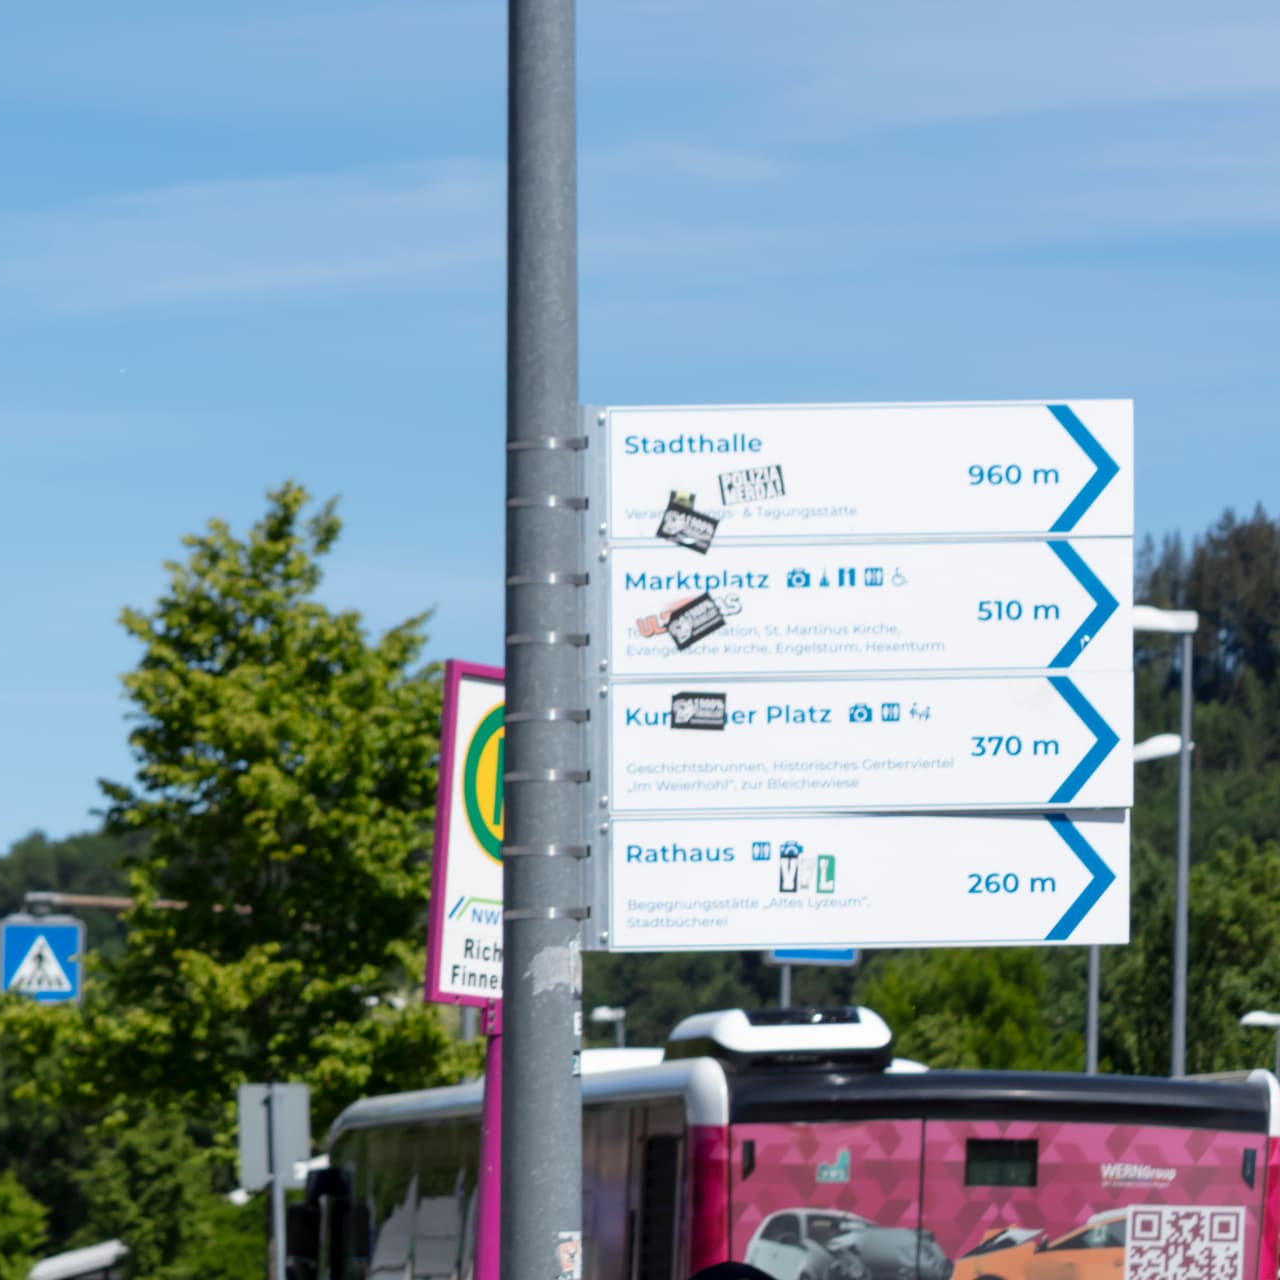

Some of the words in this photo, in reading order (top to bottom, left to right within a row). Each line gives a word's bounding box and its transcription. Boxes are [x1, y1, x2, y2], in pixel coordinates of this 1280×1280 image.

[625, 433, 763, 455] Stadthalle
[968, 464, 1023, 486] 960
[1032, 468, 1060, 485] m
[757, 505, 857, 520] Tagungsstätte
[625, 570, 769, 594] Marktplatz
[977, 600, 1023, 621] 510
[1033, 604, 1060, 621] m
[786, 624, 849, 636] Martinus
[865, 641, 945, 653] Hexenturm
[767, 704, 832, 724] Platz
[971, 736, 1023, 757] 370
[1032, 739, 1060, 756] m
[773, 759, 858, 772] Historisches
[862, 757, 954, 771] Gerberviertel
[741, 780, 763, 791] zur
[626, 843, 735, 863] Rathaus
[967, 872, 1020, 894] 260
[1029, 876, 1057, 893] m
[627, 898, 759, 913] Begegnungsstätte
[627, 916, 728, 929] Stadtbücherei
